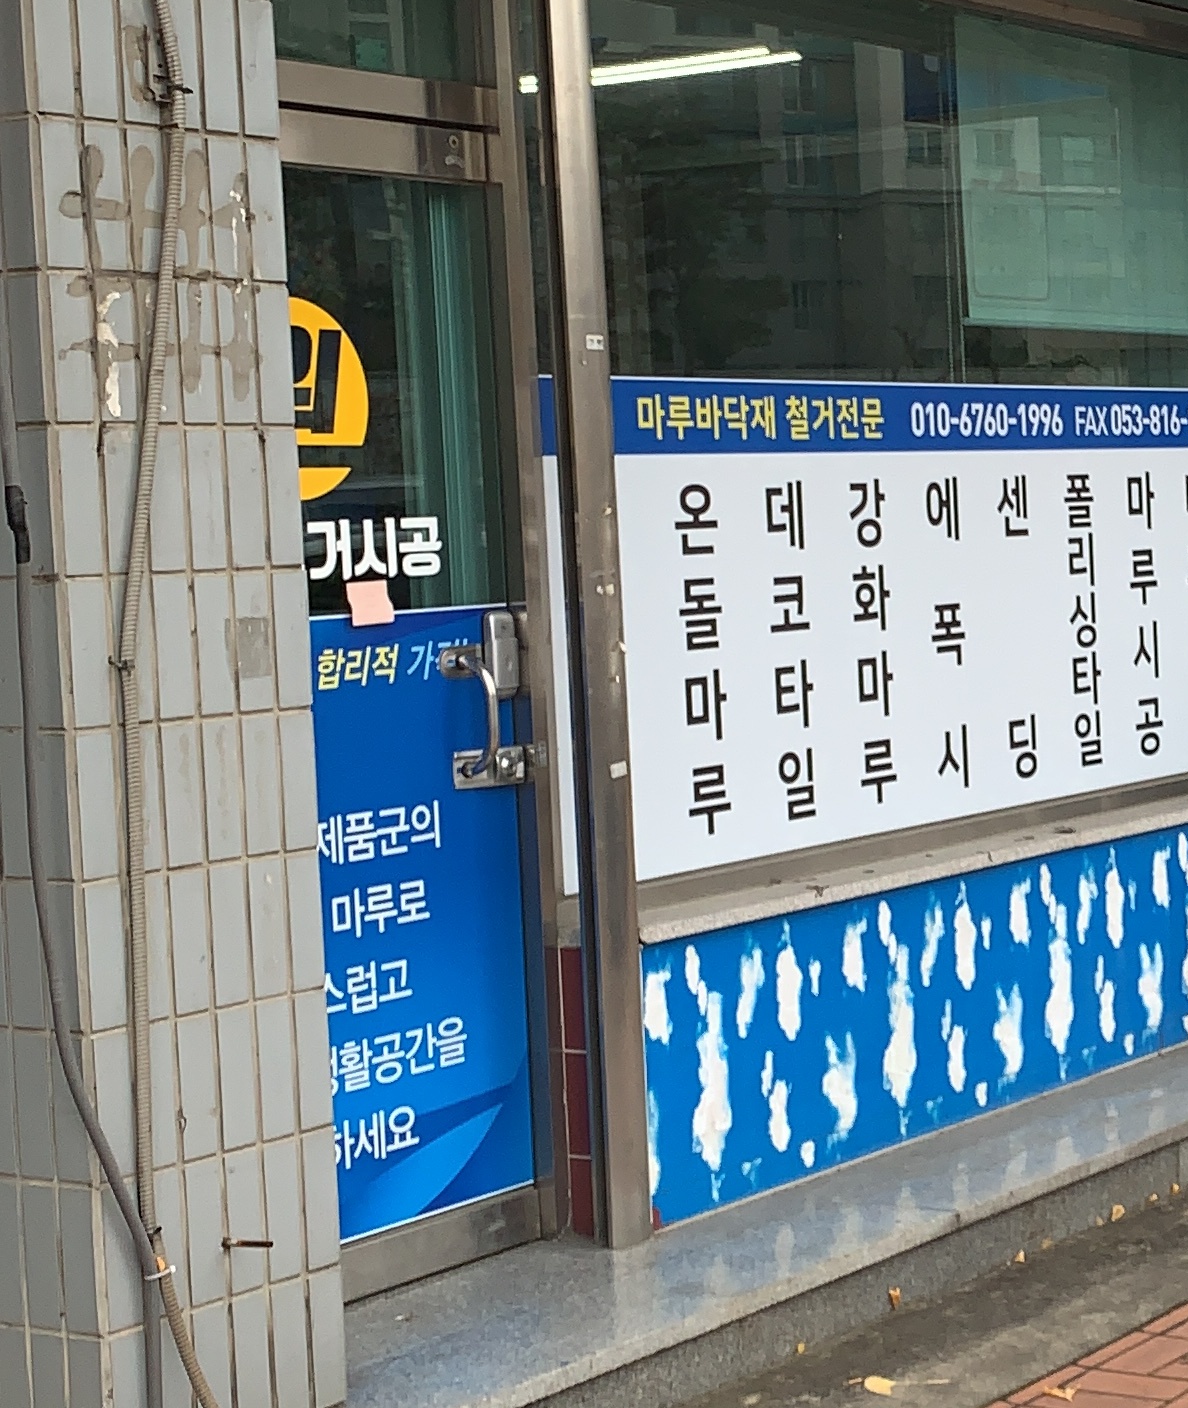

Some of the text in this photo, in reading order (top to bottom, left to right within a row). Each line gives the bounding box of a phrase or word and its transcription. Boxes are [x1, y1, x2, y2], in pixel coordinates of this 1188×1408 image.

[637, 394, 885, 440] 마루바닥재 철거전문
[911, 403, 1063, 437] 010-6760-1996
[302, 516, 443, 582] 거시공
[318, 643, 399, 690] 합리적
[331, 879, 430, 938] 마루로
